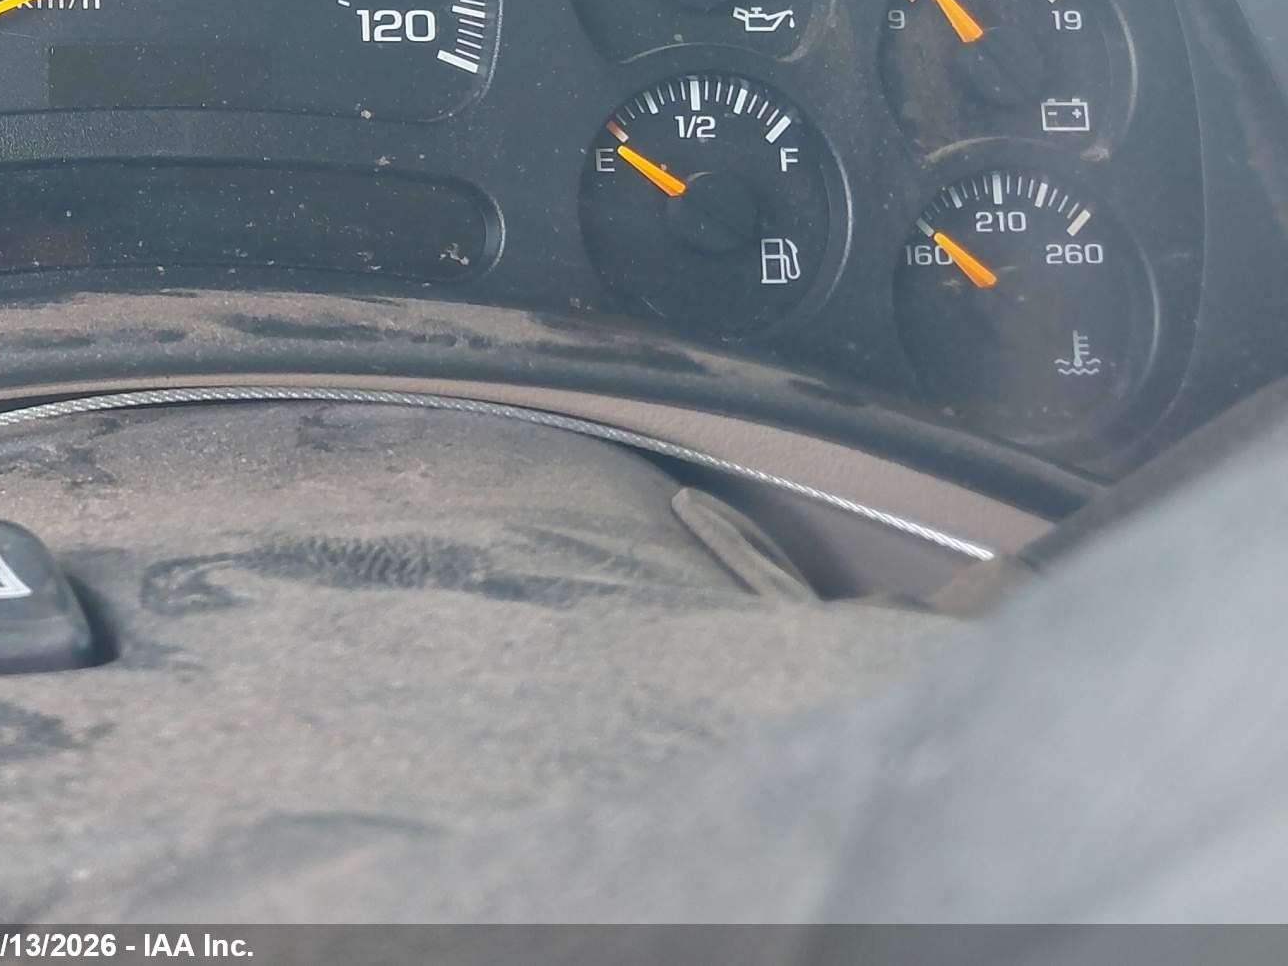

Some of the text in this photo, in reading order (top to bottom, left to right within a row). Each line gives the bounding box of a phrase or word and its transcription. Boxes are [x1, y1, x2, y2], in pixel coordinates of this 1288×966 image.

[356, 9, 436, 42] 120
[887, 9, 905, 30] 9
[1052, 10, 1082, 30] 19
[675, 116, 716, 139] 1/2
[595, 149, 615, 172] E
[780, 148, 799, 171] F
[975, 212, 1026, 232] 210
[904, 245, 953, 266] 160
[1045, 244, 1103, 265] 260
